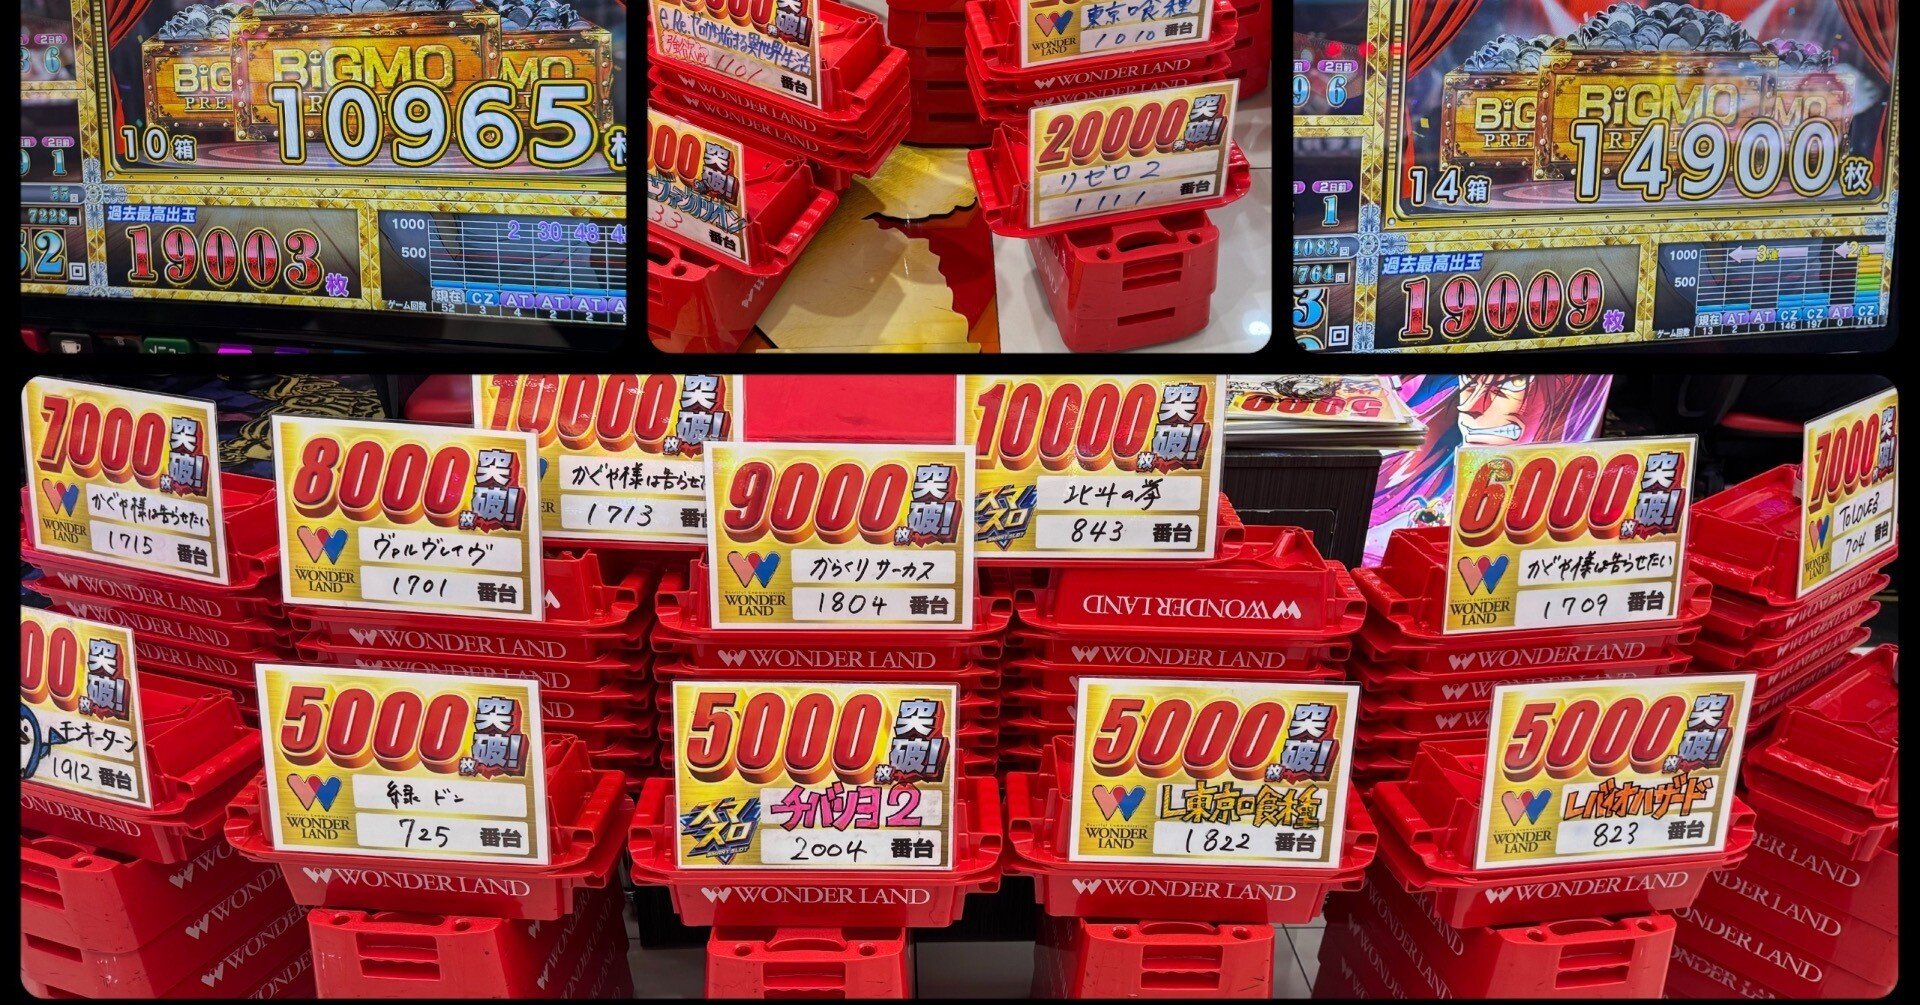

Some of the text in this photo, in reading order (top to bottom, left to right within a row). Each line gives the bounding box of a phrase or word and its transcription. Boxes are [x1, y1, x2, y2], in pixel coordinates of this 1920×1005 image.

[1095, 30, 1156, 48] 1010
[1165, 21, 1193, 37] 番台
[1031, 37, 1077, 51] WONDER
[45, 46, 61, 73] 6
[715, 54, 763, 82] 1101
[1325, 61, 1352, 72] 2日前
[780, 74, 808, 95] 番台
[1327, 75, 1347, 107] 6
[185, 96, 227, 110] PRE
[267, 79, 599, 169] 10965
[1038, 98, 1190, 167] 20000
[48, 138, 70, 147] 2日前
[52, 149, 67, 176] 1
[1571, 116, 1874, 203] 14900 枚
[1180, 180, 1210, 195] 番台
[1320, 182, 1347, 192] 2日前
[1074, 190, 1146, 212] 1111
[1322, 194, 1339, 227] 1
[28, 208, 68, 223] 7228
[107, 206, 196, 223] 過去最高出玉
[392, 218, 425, 230] 1000
[507, 220, 599, 243] 2 30 48
[709, 230, 736, 252] 番台
[125, 224, 349, 297] 19003 枚
[401, 247, 426, 259] 500
[1381, 253, 1482, 275] 過去最高出玉
[1669, 250, 1697, 261] 1000
[1674, 276, 1696, 288] 500
[387, 300, 455, 313] ゲーム回数 52
[435, 288, 602, 311] 現在 CZ AT AT AT
[1399, 267, 1626, 343] 19009 枚
[1698, 304, 1875, 326] 現在 AT AT CZ CZ AT CZ
[1657, 316, 1873, 338] ゲーム回数 13 146 197 716
[489, 374, 678, 441] 10000
[976, 382, 1157, 462] 10000
[41, 396, 166, 480] 7000
[1810, 413, 1880, 505] 7000
[292, 436, 471, 517] 8000
[724, 461, 909, 536] 9000
[1459, 453, 1639, 535] 6000
[587, 503, 654, 527] 1713
[43, 518, 87, 537] WONDER
[52, 530, 79, 544] LAND
[1071, 518, 1124, 542] 843
[1152, 523, 1192, 543] 番台
[108, 531, 154, 556] 1715
[1845, 532, 1866, 562] 704
[177, 543, 208, 567] 番台
[295, 568, 355, 584] WONDER
[308, 580, 344, 594] LAND
[393, 575, 448, 598] 1701
[477, 582, 517, 604] 番台
[724, 594, 786, 607] WONDER
[818, 591, 887, 616] 1804
[1628, 591, 1665, 612] 番台
[738, 605, 774, 617] LAND
[909, 596, 949, 615] 番台
[1450, 600, 1511, 616] WONDER
[1544, 594, 1608, 619] 1709
[1461, 612, 1497, 626] LAND
[378, 629, 567, 660] WONDER LAND
[1478, 642, 1646, 668] WONDER LAND
[748, 649, 936, 669] WONDER LAND
[1100, 646, 1286, 669] WONDER LAND
[280, 685, 470, 764] 5000
[687, 692, 883, 773] 5000
[1092, 698, 1286, 770] 5000
[1504, 695, 1687, 771] 5000
[59, 721, 137, 752] モンキーターン
[53, 757, 92, 783] 1912
[99, 766, 132, 791] 番台
[287, 816, 350, 831] WONDER
[302, 828, 339, 840] LAND
[399, 818, 450, 848] 725
[1085, 827, 1148, 840] WONDER
[1593, 822, 1639, 847] 823
[1668, 820, 1705, 841] 番台
[479, 827, 522, 848] 番台
[891, 838, 934, 858] 番台
[1098, 838, 1134, 849] LAND
[1186, 828, 1250, 854] 1822
[1275, 832, 1317, 853] 番台
[1493, 830, 1551, 844] WONDER
[1504, 842, 1538, 854] LAND
[790, 837, 867, 863] 2004
[333, 868, 531, 897] WONDER LAND
[1102, 879, 1297, 902] WONDER LAND
[1515, 872, 1689, 899] WONDER LAND
[732, 886, 931, 905] WONDER LAND
